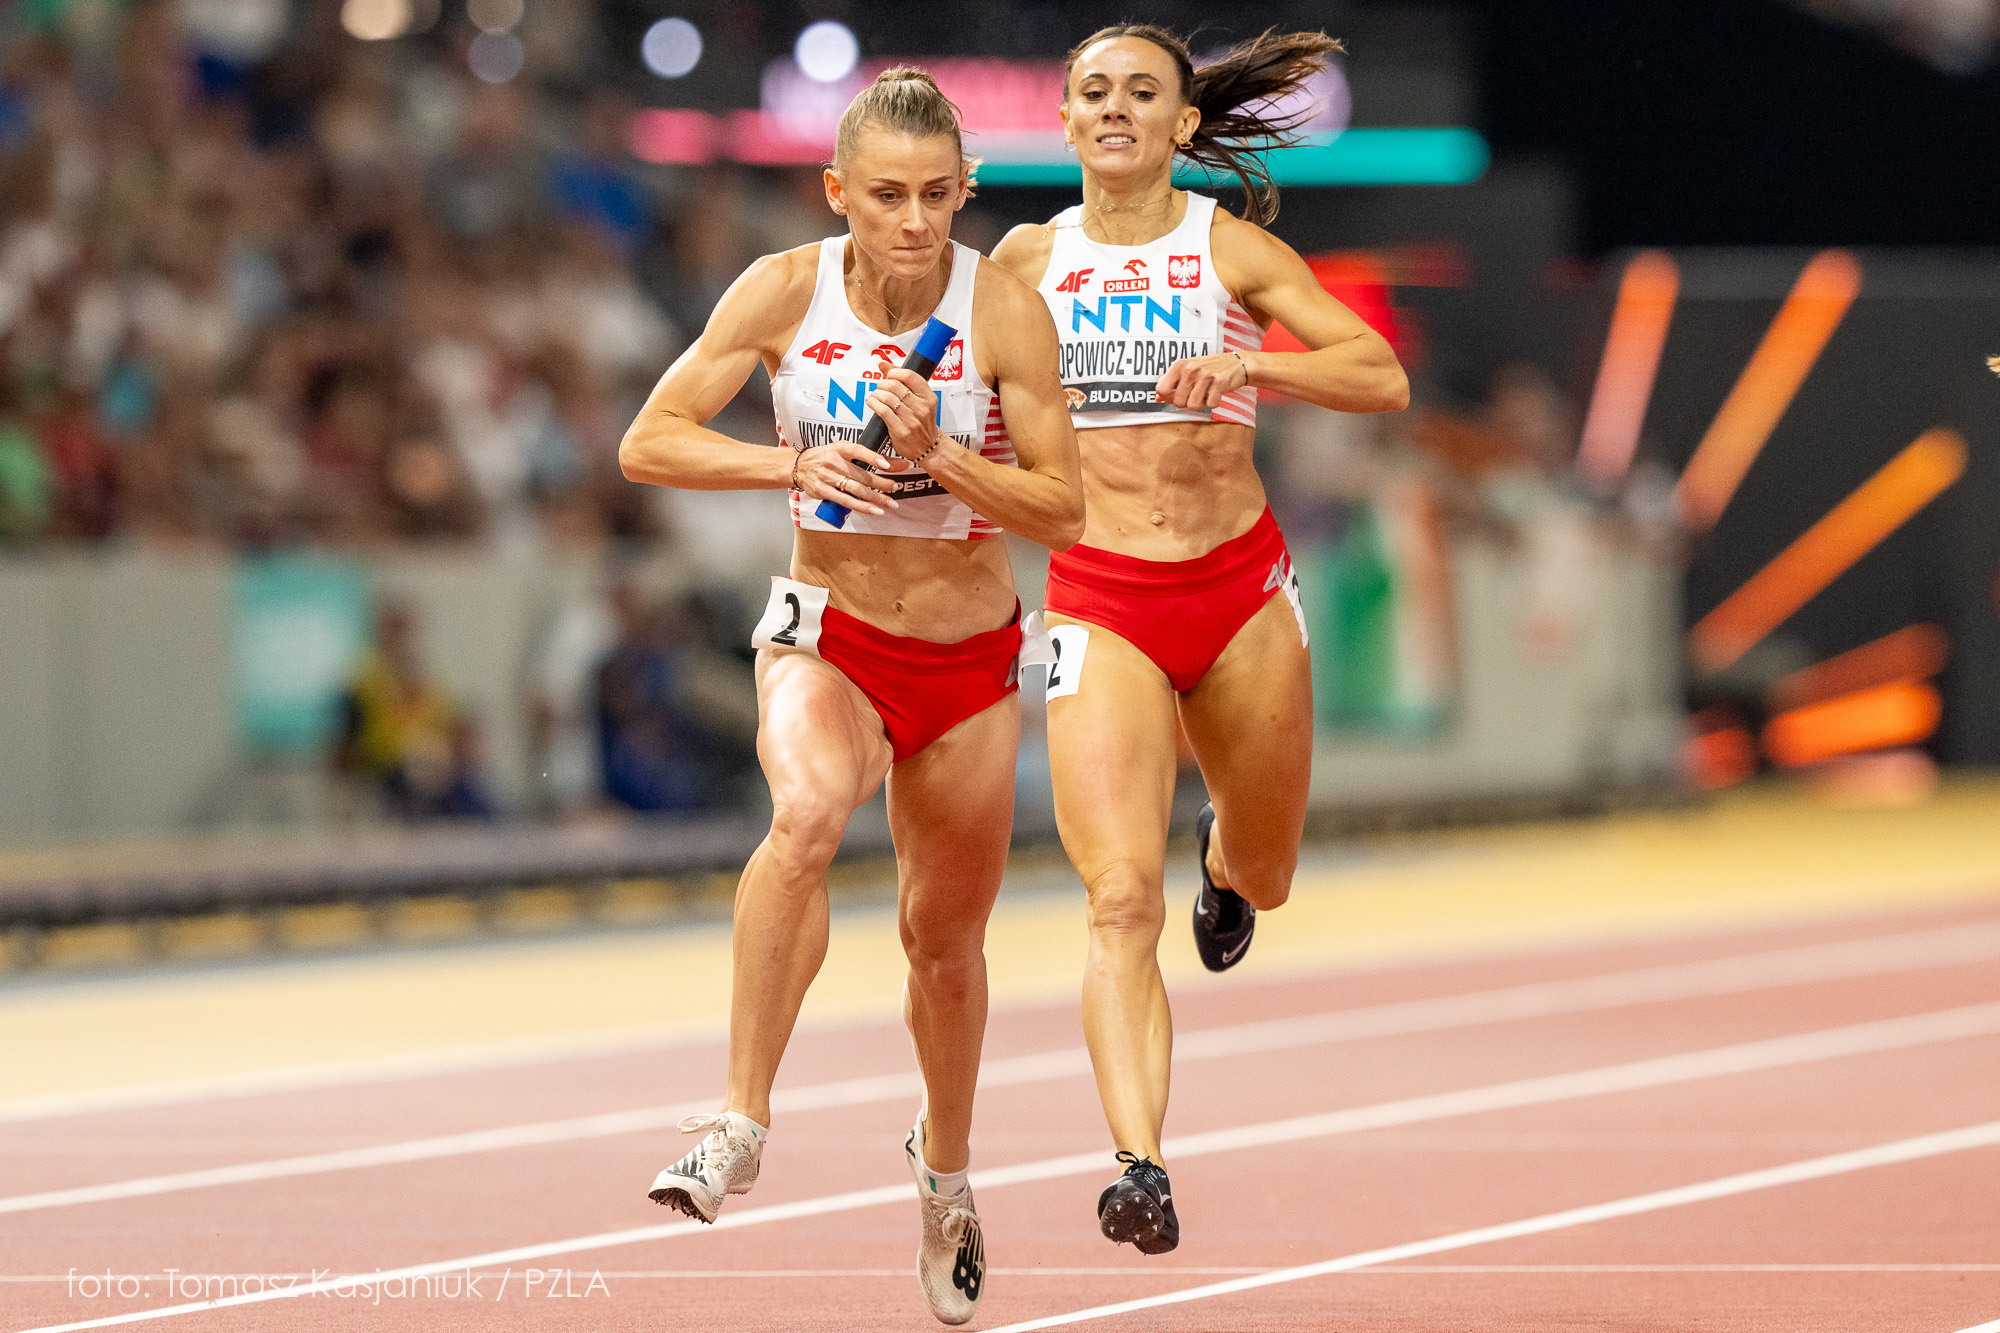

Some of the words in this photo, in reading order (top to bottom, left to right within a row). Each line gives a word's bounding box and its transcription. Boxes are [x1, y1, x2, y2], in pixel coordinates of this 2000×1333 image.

[1056, 268, 1095, 293] 4F
[1106, 279, 1148, 292] ORLEN
[1072, 295, 1182, 334] NTN
[802, 339, 852, 366] 4F
[1089, 390, 1158, 404] BUDAPE
[770, 592, 801, 647] 2
